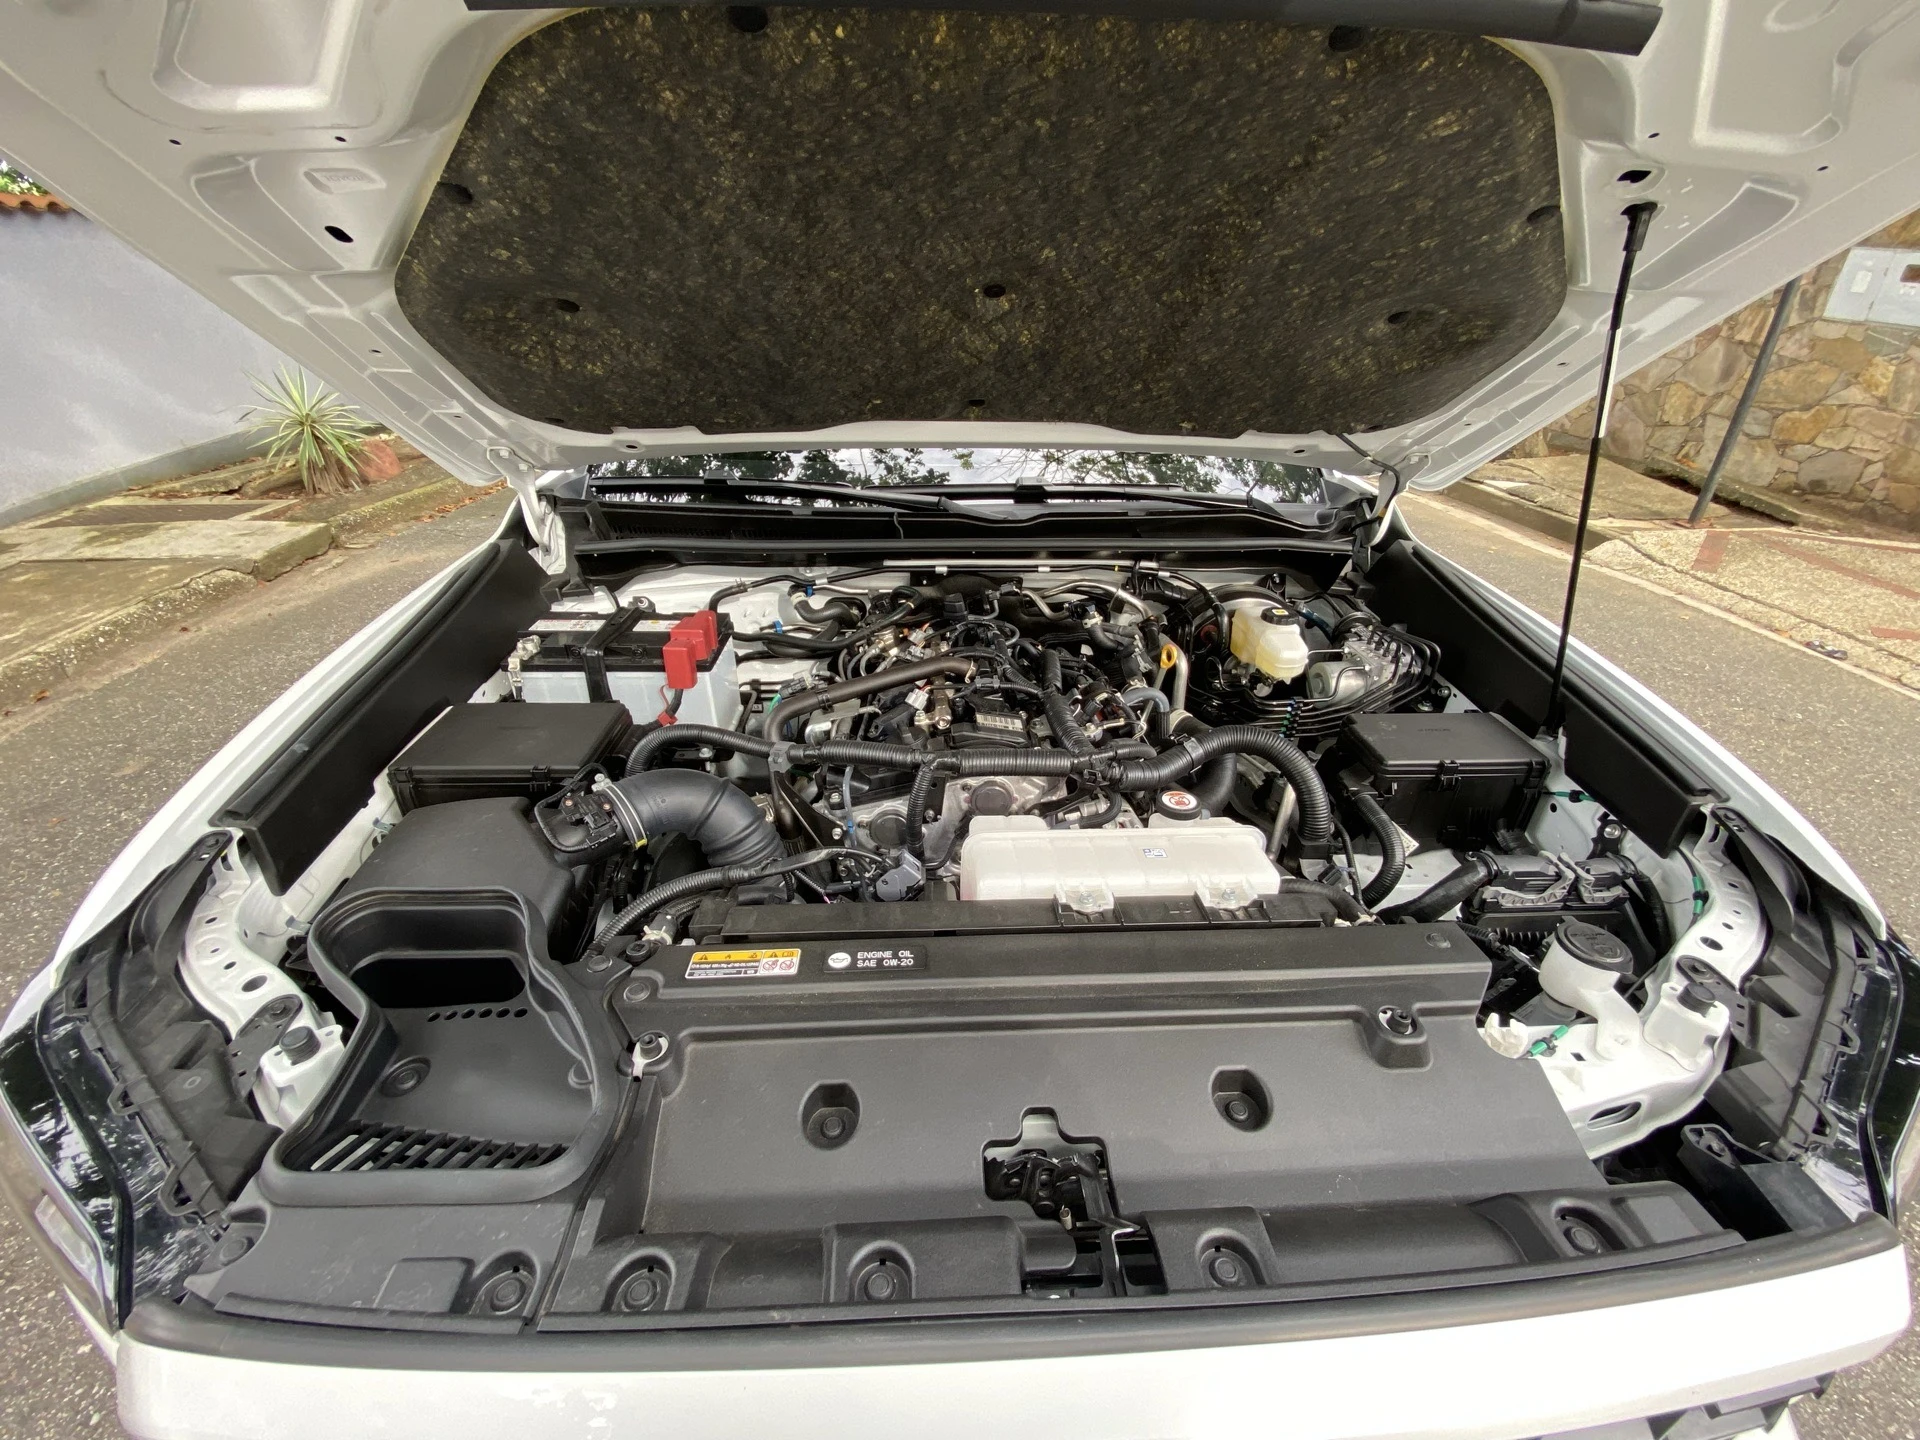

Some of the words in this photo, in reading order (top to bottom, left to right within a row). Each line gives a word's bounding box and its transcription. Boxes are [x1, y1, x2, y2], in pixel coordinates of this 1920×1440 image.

[857, 950, 893, 959] ENGINE
[898, 950, 914, 958] OIL
[856, 959, 877, 968] SAE
[883, 958, 914, 967] 0W-20
